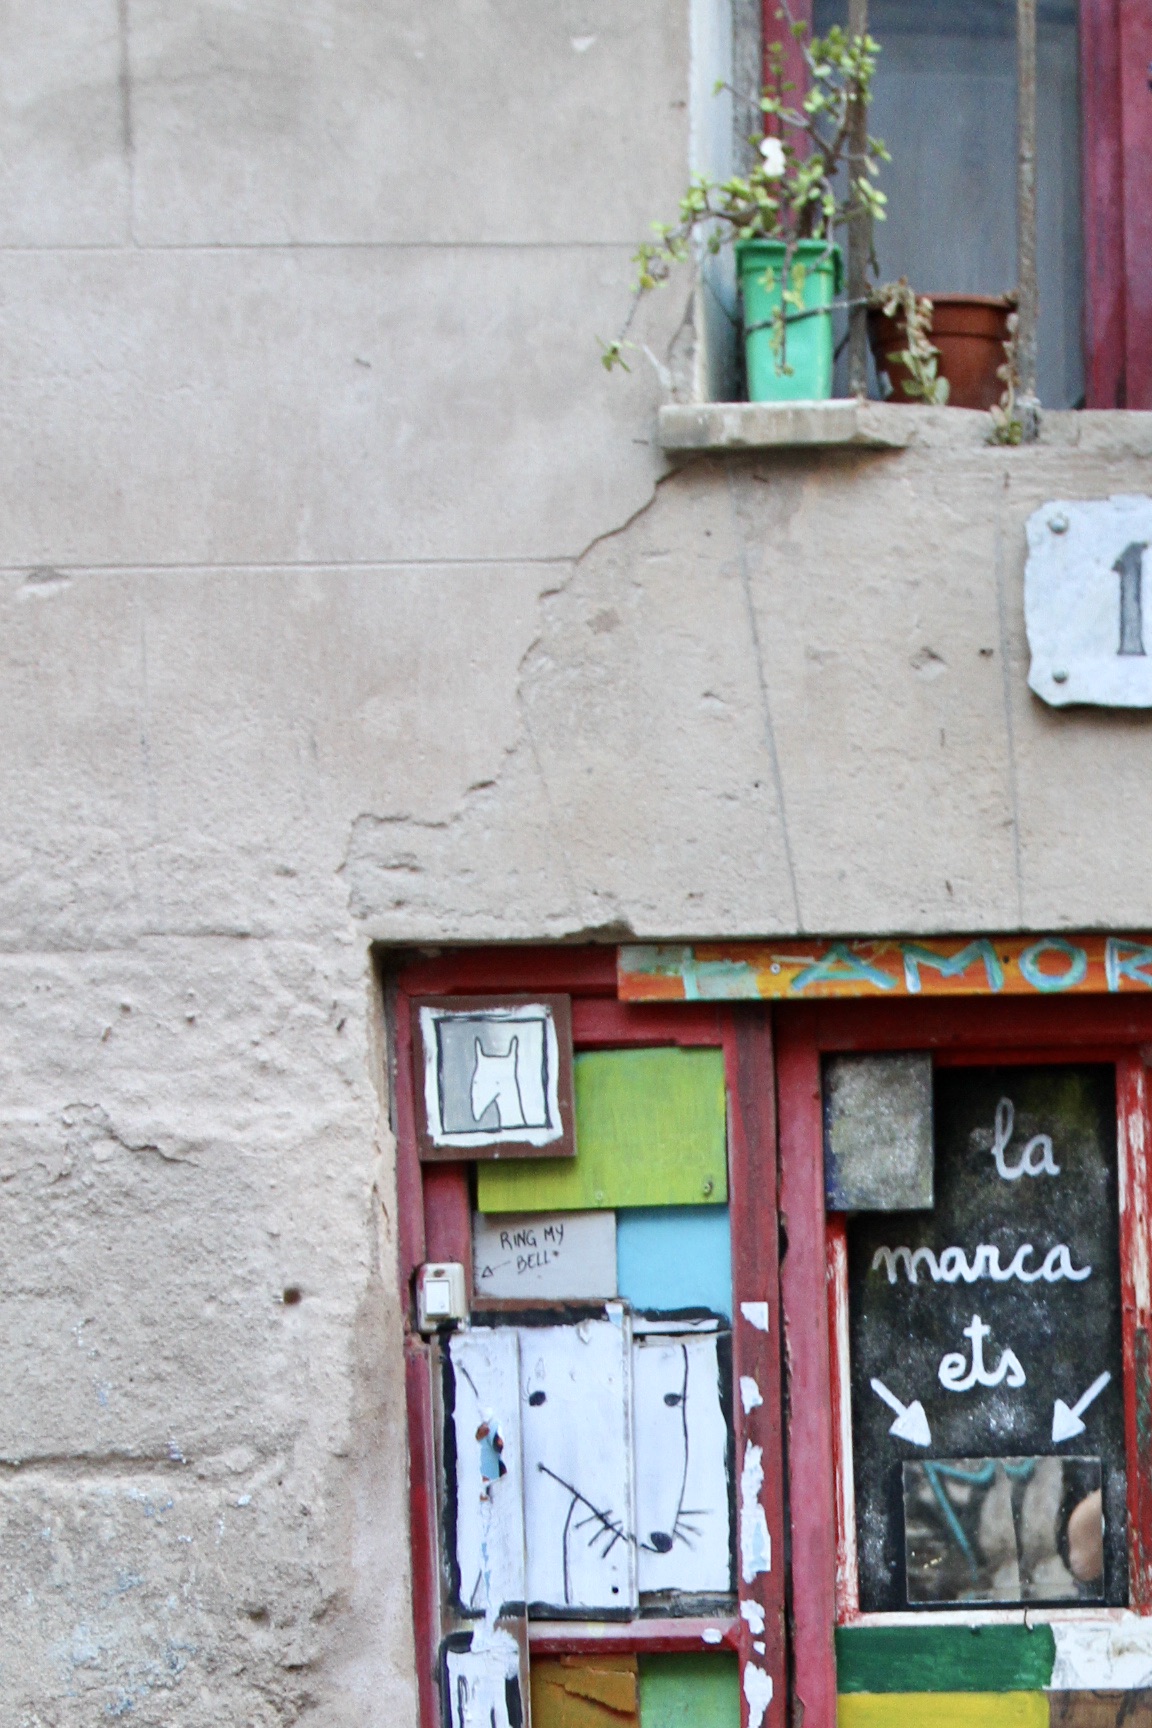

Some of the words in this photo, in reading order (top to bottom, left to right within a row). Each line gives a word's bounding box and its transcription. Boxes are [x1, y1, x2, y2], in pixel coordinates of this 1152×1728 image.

[1111, 540, 1149, 657] 1
[991, 1097, 1061, 1180] la
[500, 1230, 537, 1250] RING
[543, 1224, 564, 1244] MY
[872, 1243, 1092, 1284] marca
[938, 1314, 1026, 1392] ets
